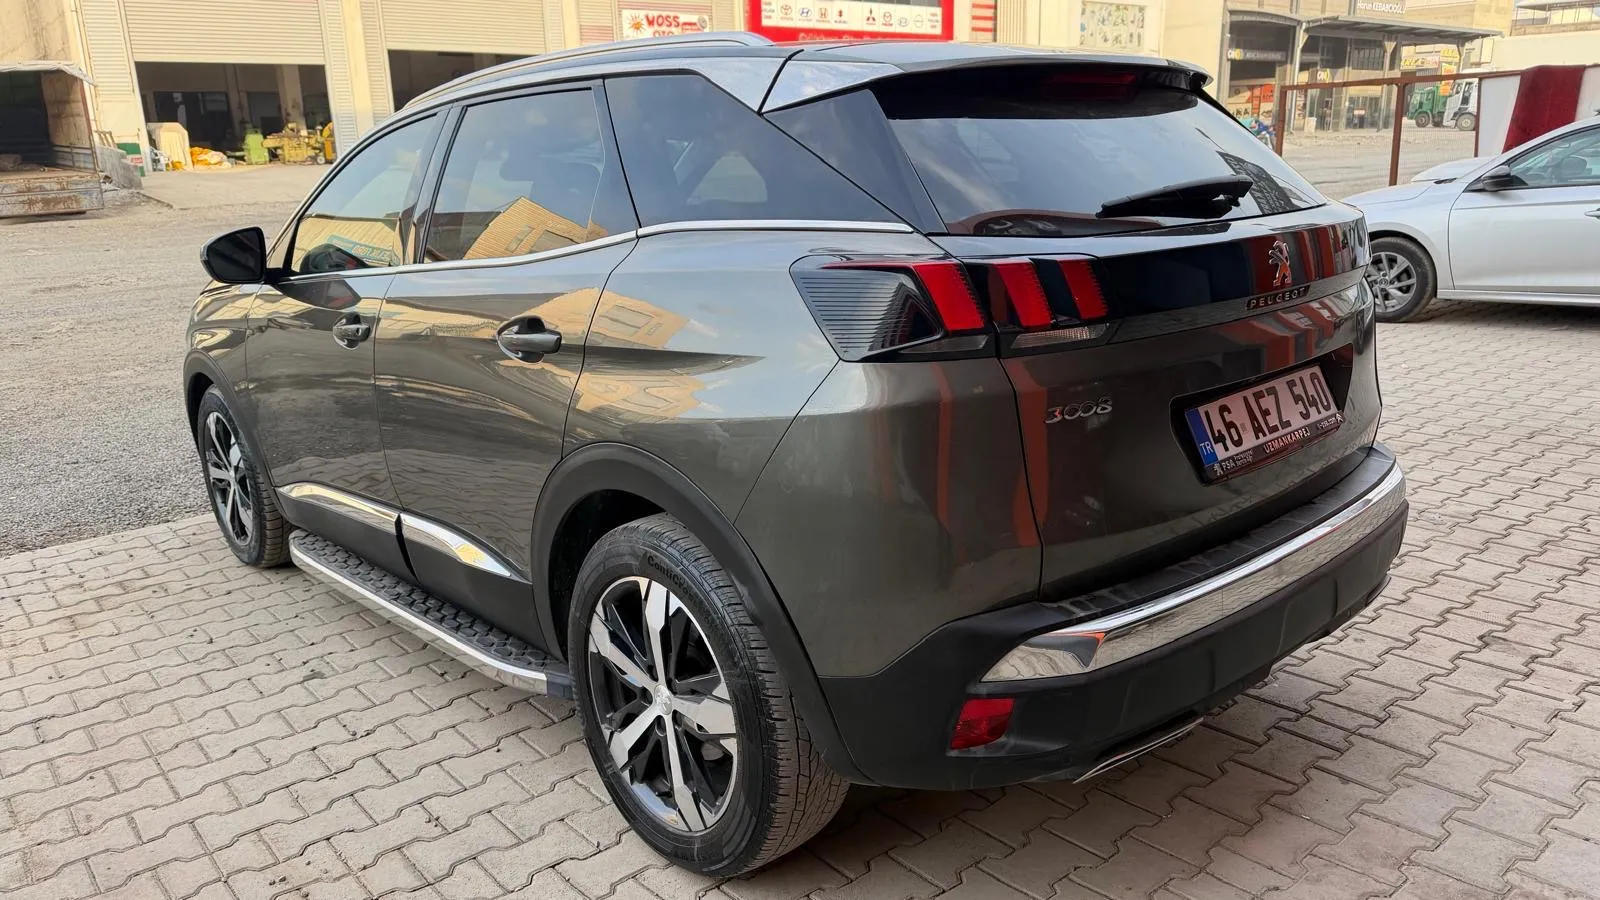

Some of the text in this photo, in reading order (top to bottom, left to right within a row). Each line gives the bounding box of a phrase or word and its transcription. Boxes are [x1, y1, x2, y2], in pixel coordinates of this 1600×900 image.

[644, 14, 680, 28] WOSS
[1249, 287, 1305, 308] PEUGEOT
[1045, 396, 1113, 424] 3008
[1204, 372, 1331, 452] 46 AEZ 540
[1200, 442, 1213, 456] TR
